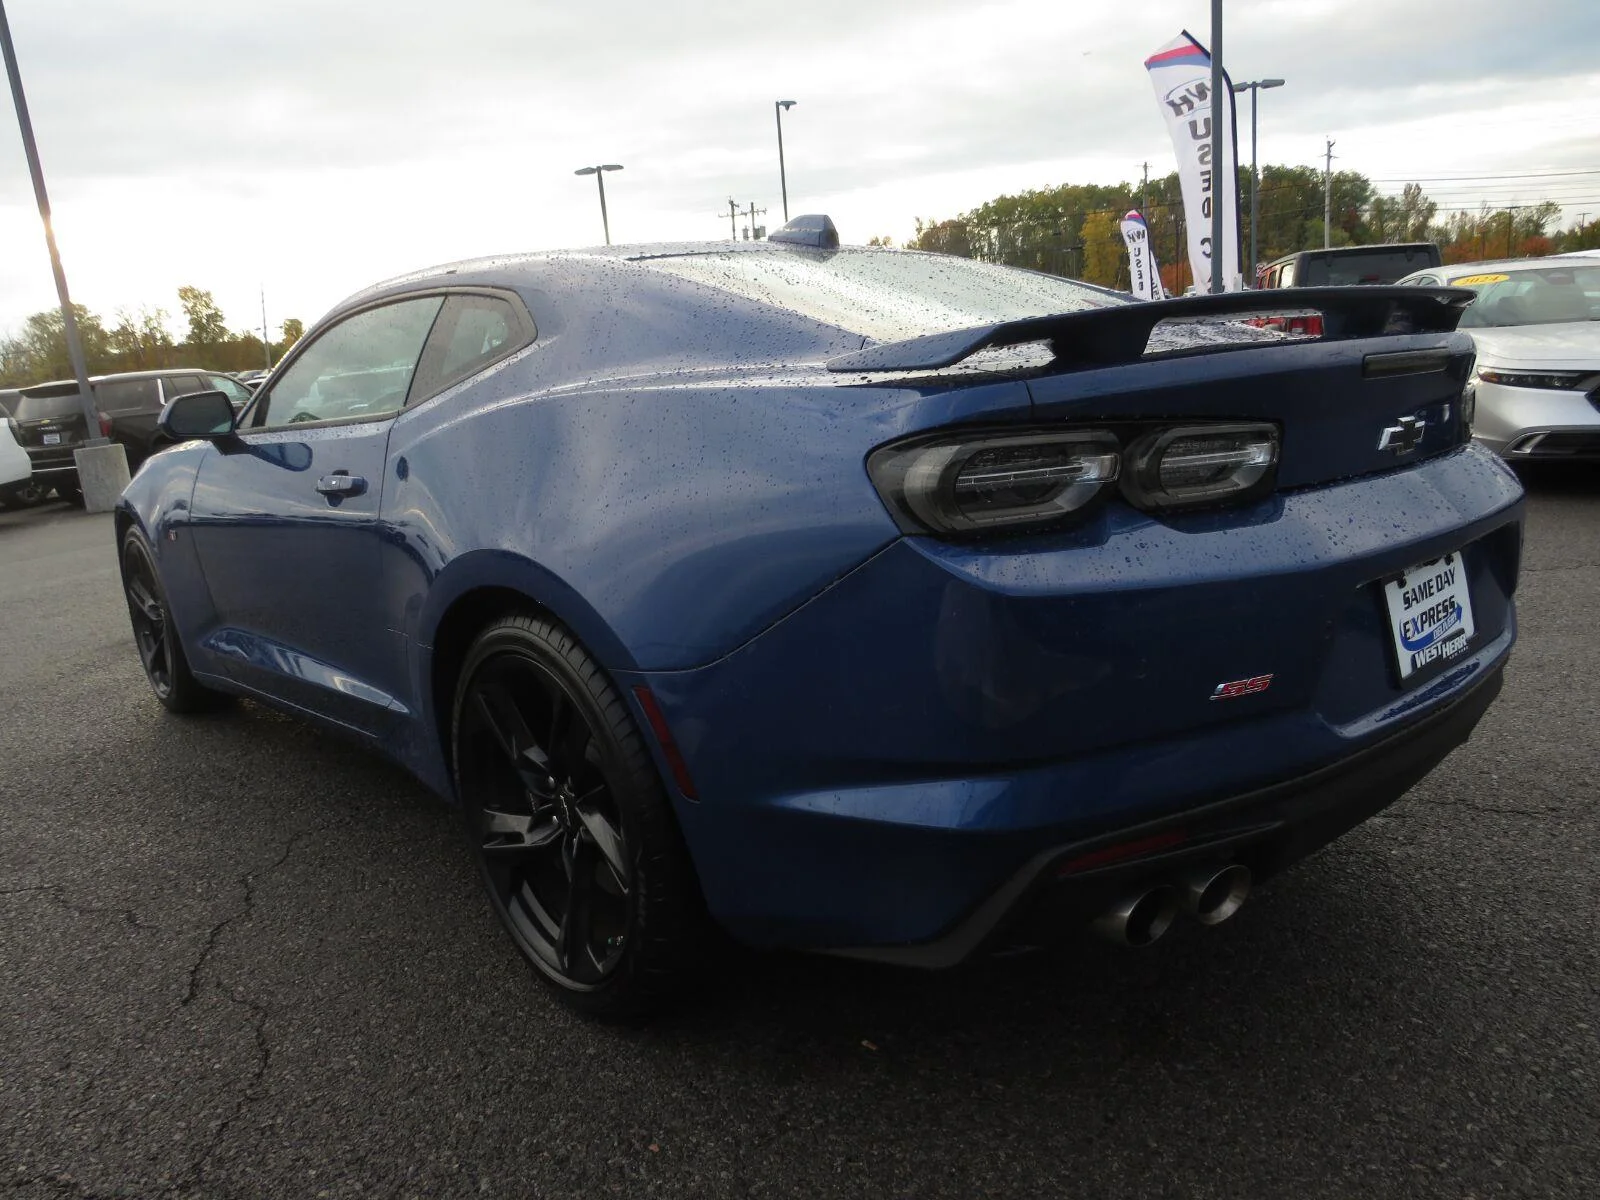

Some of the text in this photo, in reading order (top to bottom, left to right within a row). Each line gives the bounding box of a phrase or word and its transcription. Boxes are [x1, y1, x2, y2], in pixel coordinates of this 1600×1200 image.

[1463, 275, 1500, 285] 2024
[1402, 566, 1456, 611] SAME DAY
[1402, 594, 1456, 640] EXPRESS
[1415, 641, 1443, 668] WEST
[1441, 634, 1468, 659] HERR
